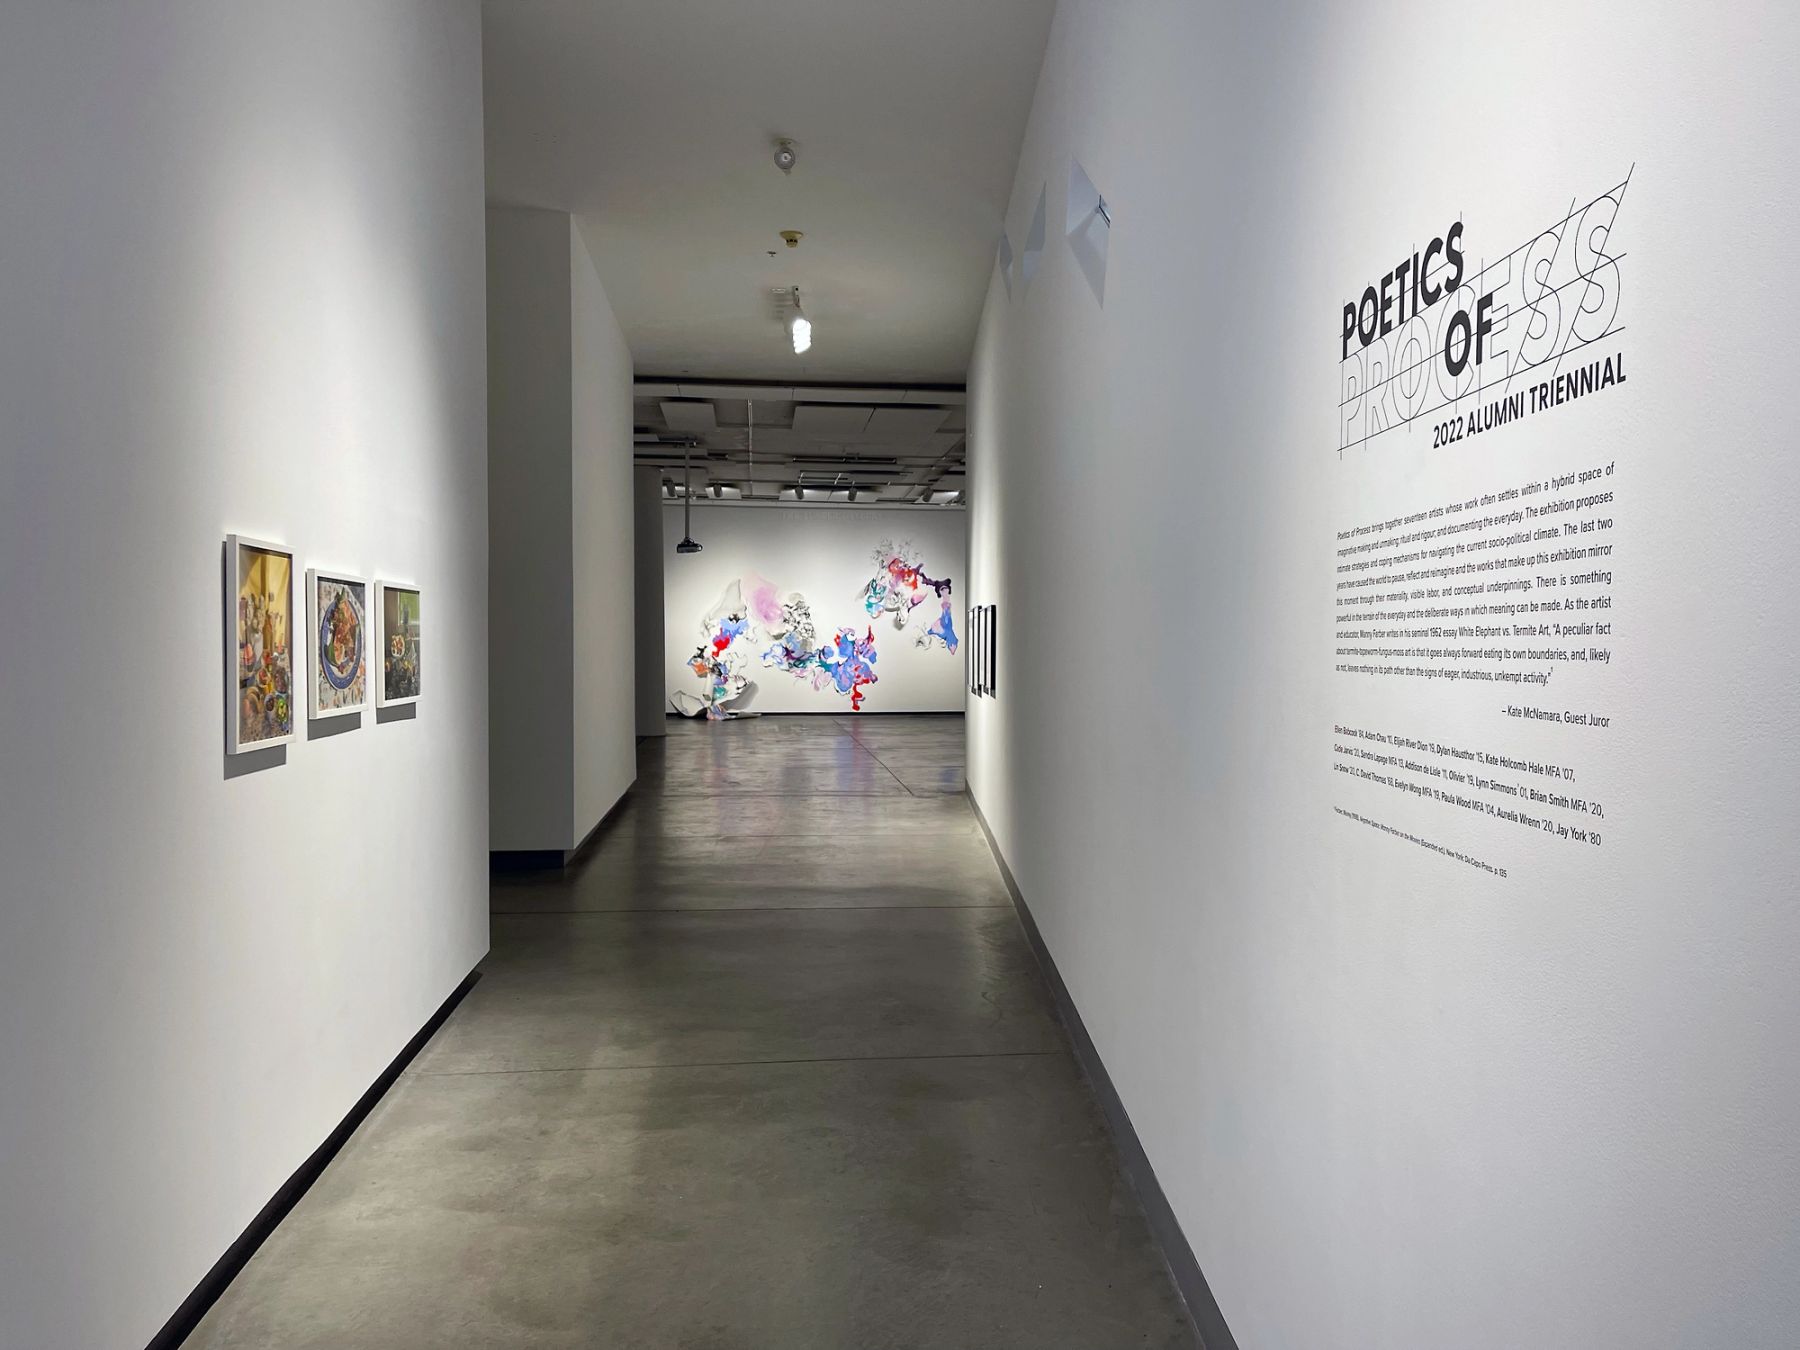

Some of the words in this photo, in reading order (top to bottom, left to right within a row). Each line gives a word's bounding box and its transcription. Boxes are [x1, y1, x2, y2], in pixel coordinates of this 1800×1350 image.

[1342, 221, 1465, 361] POETICS
[1340, 194, 1621, 450] PROCESS
[1444, 292, 1493, 377] OF
[1433, 416, 1463, 449] 2022
[1466, 391, 1524, 437] ALUMNI
[1529, 352, 1627, 414] TRIENNIAL
[1404, 512, 1427, 525] seventeen
[1428, 507, 1444, 519] artists
[1445, 503, 1463, 514] whose
[1464, 497, 1479, 510] work
[1480, 494, 1496, 506] often
[1498, 489, 1519, 502] settles
[1521, 481, 1542, 496] within
[1544, 481, 1549, 491] a
[1551, 472, 1575, 491] hybrid
[1578, 468, 1602, 485] space
[1605, 461, 1615, 476] of
[1411, 531, 1421, 542] and
[1437, 525, 1447, 537] and
[1447, 519, 1483, 535] documenting
[1483, 516, 1493, 528] the
[1494, 510, 1524, 525] everyday.
[1525, 506, 1538, 519] The
[1539, 499, 1575, 516] exhibition
[1576, 491, 1613, 511] proposes
[1420, 549, 1428, 560] for
[1428, 545, 1455, 559] navigating
[1456, 543, 1465, 554] the
[1466, 539, 1487, 552] current
[1488, 530, 1532, 548] socio-political
[1533, 527, 1561, 541] climate.
[1563, 523, 1578, 536] The
[1580, 519, 1595, 533] last
[1597, 518, 1613, 530] two
[1420, 569, 1430, 579] and
[1430, 566, 1455, 579] reimagine
[1455, 563, 1466, 575] and
[1466, 562, 1476, 573] the
[1477, 560, 1494, 572] works
[1494, 558, 1507, 570] that
[1508, 555, 1525, 567] make
[1526, 556, 1536, 568] up
[1536, 551, 1549, 565] this
[1550, 547, 1587, 563] exhibition
[1588, 544, 1613, 557] mirror
[1410, 589, 1425, 599] visible
[1426, 588, 1440, 598] labor,
[1442, 586, 1452, 597] and
[1454, 582, 1484, 596] conceptual
[1487, 578, 1533, 594] underpinnings.
[1536, 576, 1557, 588] There
[1560, 574, 1567, 586] is
[1570, 569, 1612, 585] something
[1407, 609, 1416, 619] and
[1416, 610, 1424, 618] the
[1424, 607, 1449, 618] deliberate
[1450, 608, 1464, 619] ways
[1464, 607, 1470, 616] in
[1471, 603, 1488, 615] which
[1489, 602, 1515, 616] meaning
[1516, 603, 1529, 613] can
[1530, 601, 1539, 612] be
[1540, 599, 1563, 612] made.
[1564, 598, 1574, 611] As
[1576, 597, 1589, 610] the
[1591, 595, 1611, 609] artist
[1411, 627, 1429, 638] seminal
[1429, 627, 1442, 637] 1962
[1442, 629, 1458, 640] essay
[1458, 626, 1474, 637] White
[1475, 625, 1501, 639] Elephant
[1502, 627, 1511, 637] vs.
[1512, 624, 1537, 636] Termite
[1538, 624, 1551, 637] Art,
[1562, 622, 1594, 638] peculiar
[1595, 622, 1611, 635] fact
[1405, 666, 1416, 676] than
[1416, 667, 1424, 677] the
[1424, 667, 1437, 680] signs
[1437, 667, 1444, 678] of
[1444, 670, 1460, 681] eager,
[1461, 668, 1494, 682] industrious,
[1494, 670, 1522, 684] unkempt
[1416, 647, 1426, 657] that
[1426, 648, 1430, 657] it
[1429, 649, 1442, 660] goes
[1443, 648, 1461, 661] always
[1461, 647, 1483, 658] forward
[1483, 647, 1503, 662] eating
[1503, 648, 1511, 659] its
[1512, 650, 1526, 659] own
[1527, 648, 1569, 662] boundaries,
[1570, 648, 1588, 662] and,
[1589, 648, 1611, 664] likely
[1507, 705, 1522, 718] Kate
[1523, 706, 1562, 724] McNamara,
[1564, 711, 1587, 725] Guest
[1588, 713, 1610, 728] Juror
[1436, 744, 1451, 757] Dylan
[1476, 752, 1485, 764] '15,
[1485, 753, 1499, 766] Kate
[1499, 756, 1527, 772] Holcomb
[1528, 761, 1544, 775] Hale
[1545, 764, 1561, 779] MFA
[1562, 767, 1575, 783] '07,
[1429, 766, 1441, 778] Lisle
[1448, 770, 1466, 783] Olivier
[1475, 776, 1489, 790] Lynn
[1530, 788, 1547, 803] Brian
[1548, 793, 1569, 809] Smith
[1570, 798, 1588, 813] MFA
[1589, 802, 1604, 819] '20,
[1441, 791, 1455, 805] Paula
[1456, 795, 1471, 809] Wood
[1472, 800, 1484, 813] MFA
[1496, 807, 1518, 823] Aurelia
[1519, 812, 1541, 829] Wrenn
[1541, 819, 1555, 835] '20,
[1556, 823, 1569, 840] Jay
[1570, 826, 1587, 843] York
[1588, 831, 1601, 846] '80
